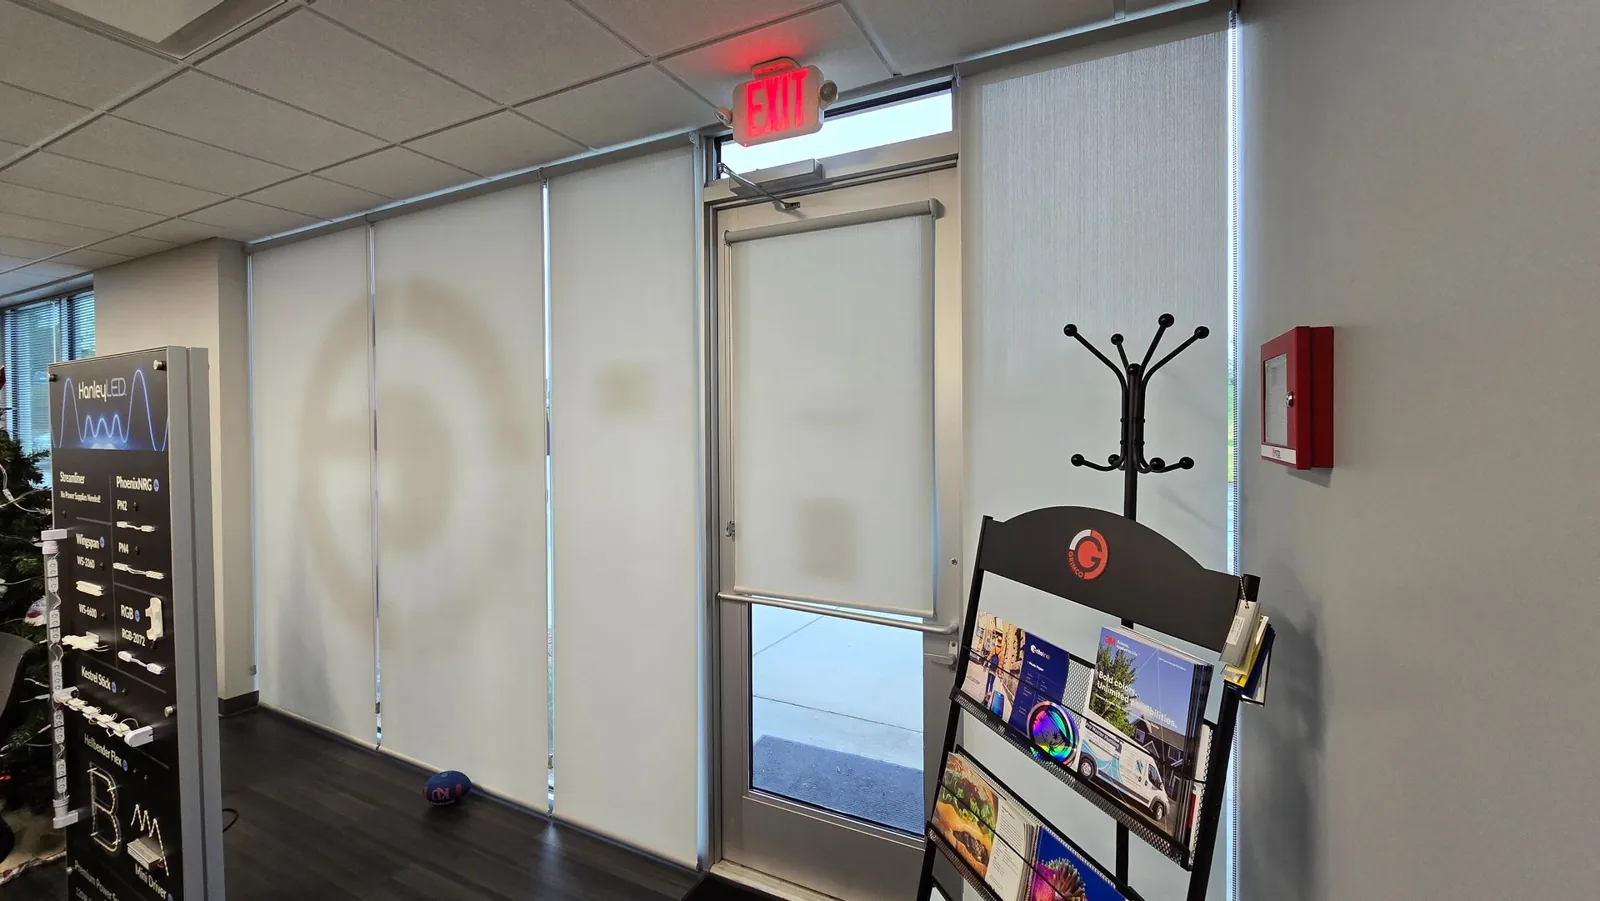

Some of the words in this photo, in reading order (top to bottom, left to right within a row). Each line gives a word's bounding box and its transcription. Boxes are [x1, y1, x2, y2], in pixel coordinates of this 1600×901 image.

[746, 67, 808, 138] EXIT
[60, 471, 85, 484] Streamliner
[116, 475, 152, 492] PhoenixNRG
[116, 499, 128, 511] PN2
[76, 533, 100, 550] Wingspan
[118, 541, 129, 555] PN4
[1068, 550, 1084, 578] GRIMCO
[121, 604, 134, 620] RGB
[121, 627, 146, 647] RGB-2072
[81, 664, 98, 684] Kestrel
[98, 672, 112, 691] Stick
[1098, 670, 1114, 684] Bold
[1097, 680, 1130, 703] Unlimited
[84, 732, 111, 759] Hellbender
[111, 748, 123, 767] Flex
[135, 863, 147, 884] Mini
[148, 875, 167, 900] Driver
